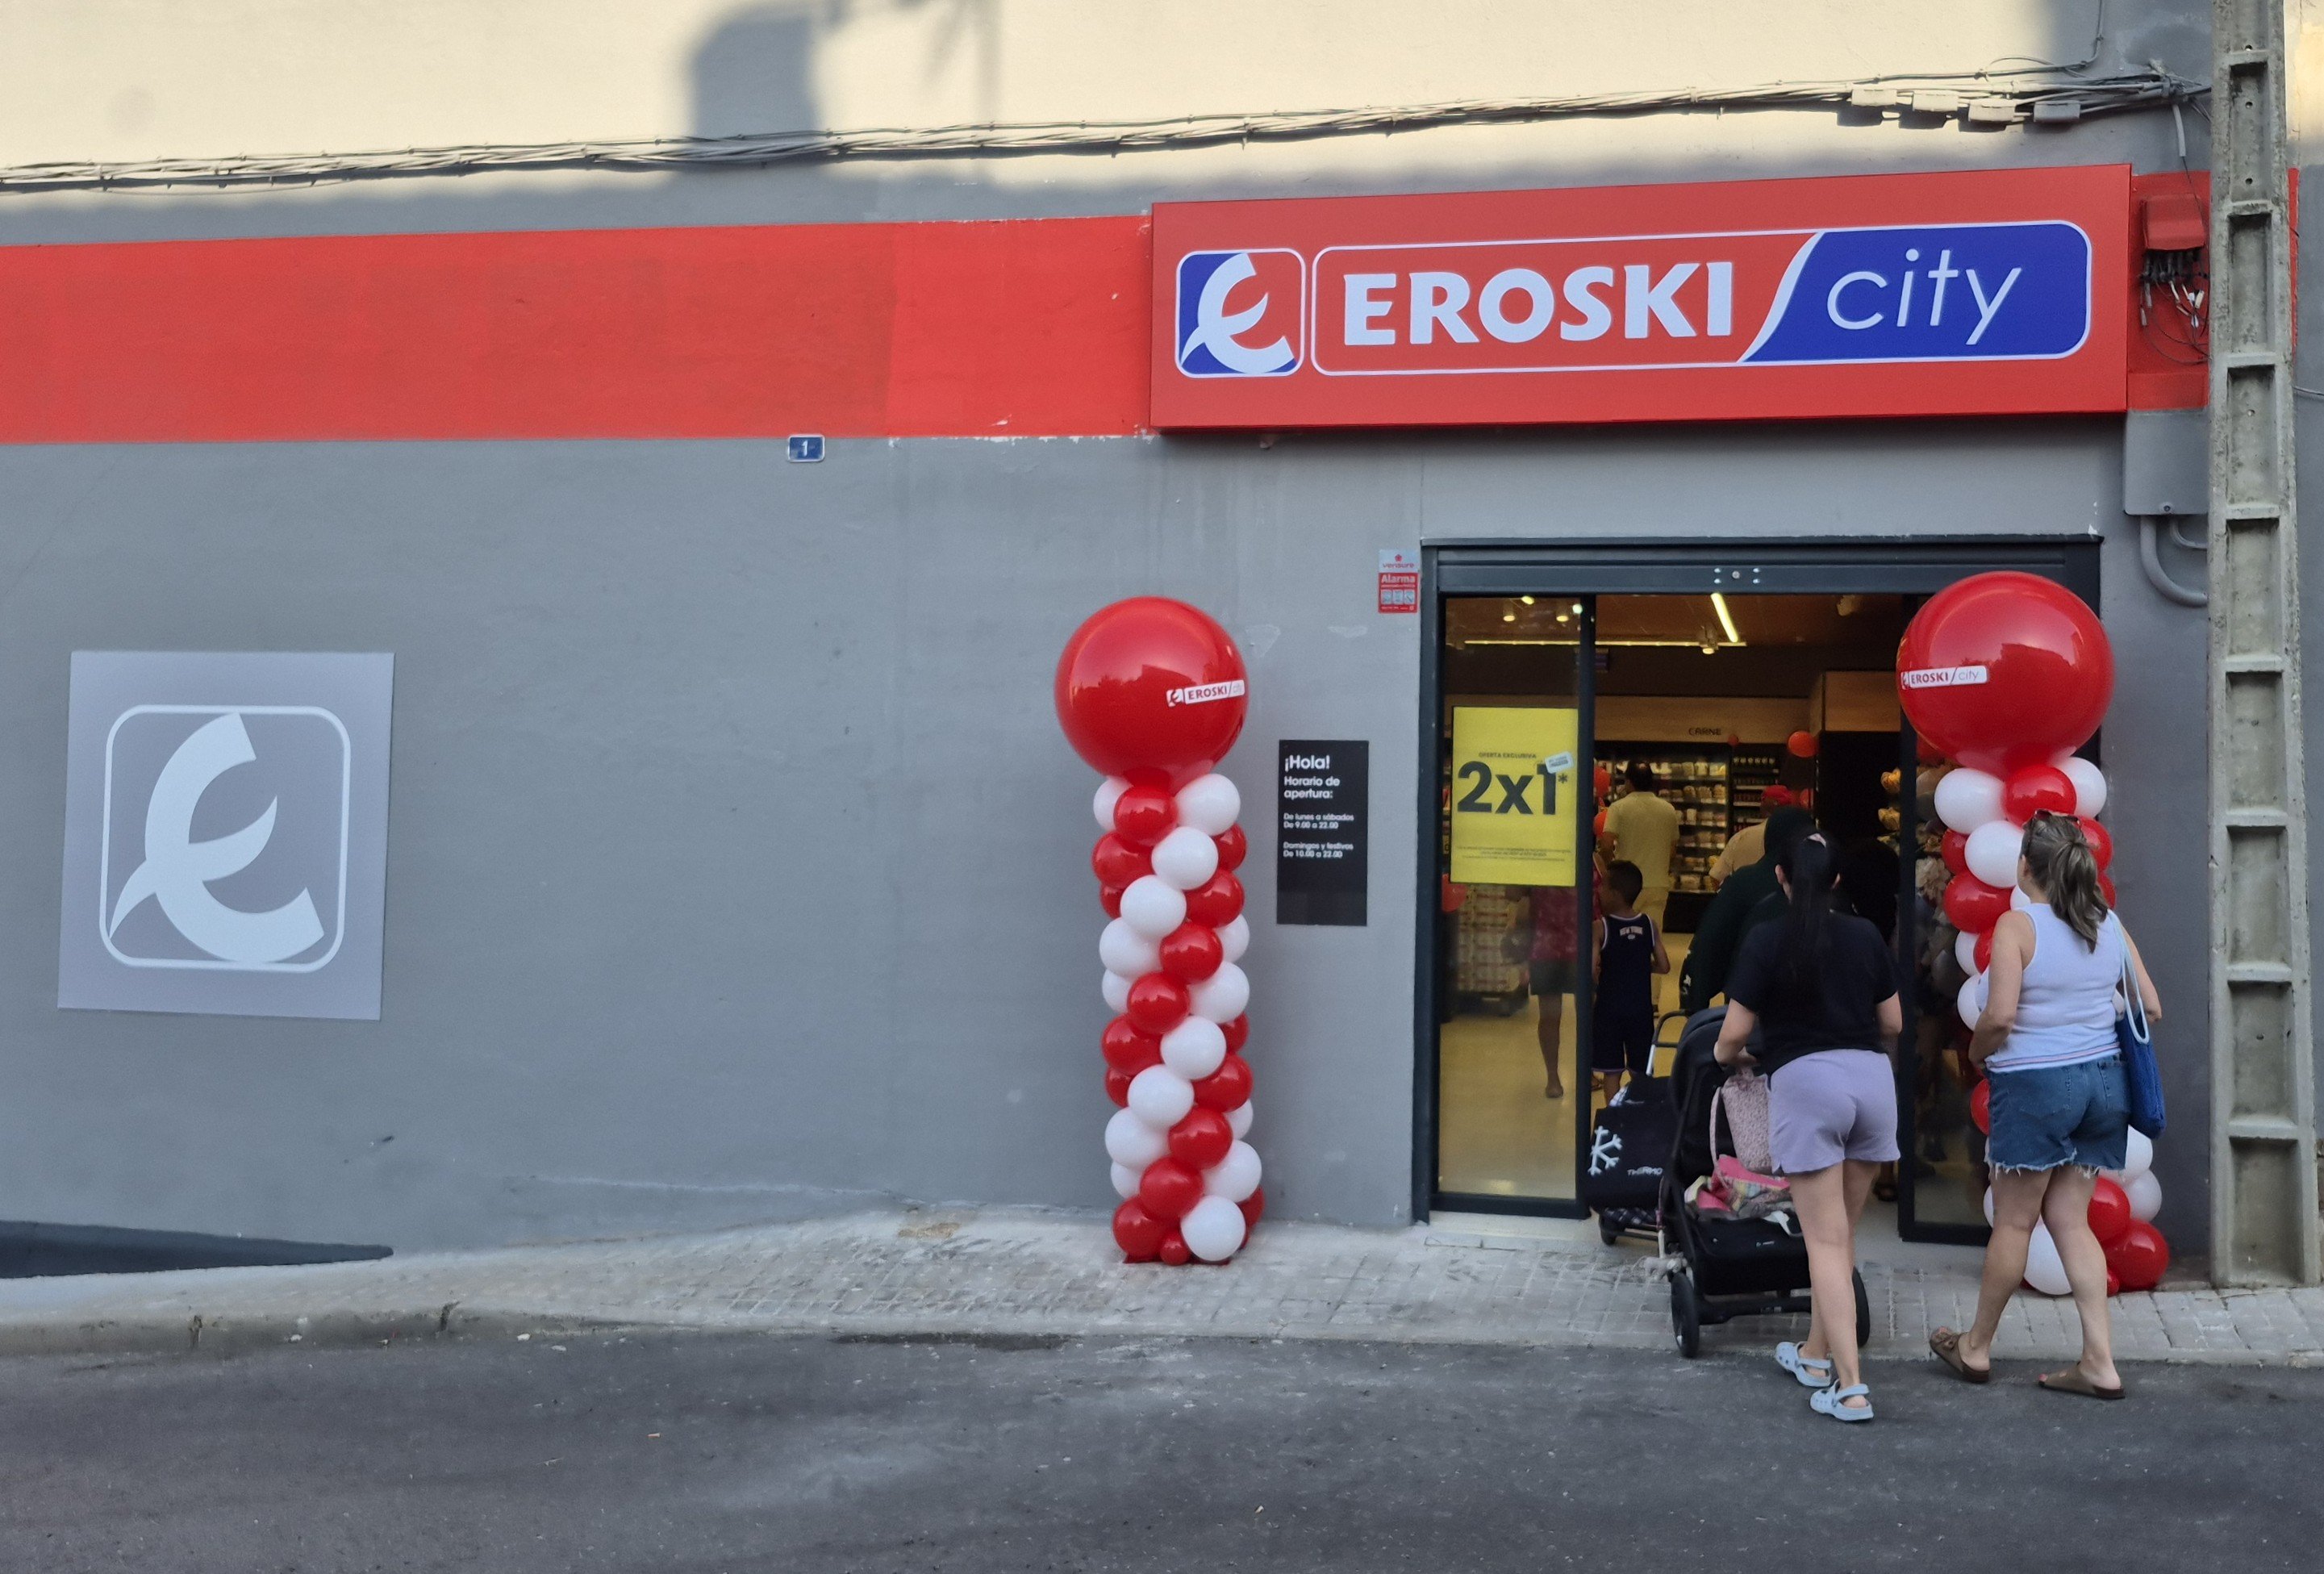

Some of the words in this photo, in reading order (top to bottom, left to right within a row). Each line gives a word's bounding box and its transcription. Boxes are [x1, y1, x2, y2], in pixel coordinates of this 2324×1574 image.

[1343, 261, 1732, 346] EROSKI
[1826, 248, 2022, 346] city
[802, 440, 807, 457] 1
[1381, 574, 1415, 583] Alarma
[1911, 672, 1948, 684] EROSKI
[1959, 669, 1979, 682] city
[1188, 685, 1226, 700] EROSKI
[1688, 728, 1721, 736] CARNE
[1284, 755, 1329, 772] ¡Hola!
[1283, 776, 1323, 786] Horario
[1325, 776, 1340, 787] de
[1283, 788, 1333, 800] apertura:
[1283, 812, 1294, 820] De
[1295, 812, 1314, 820] lunes
[1283, 841, 1320, 851] Domingos
[1283, 850, 1294, 858] De
